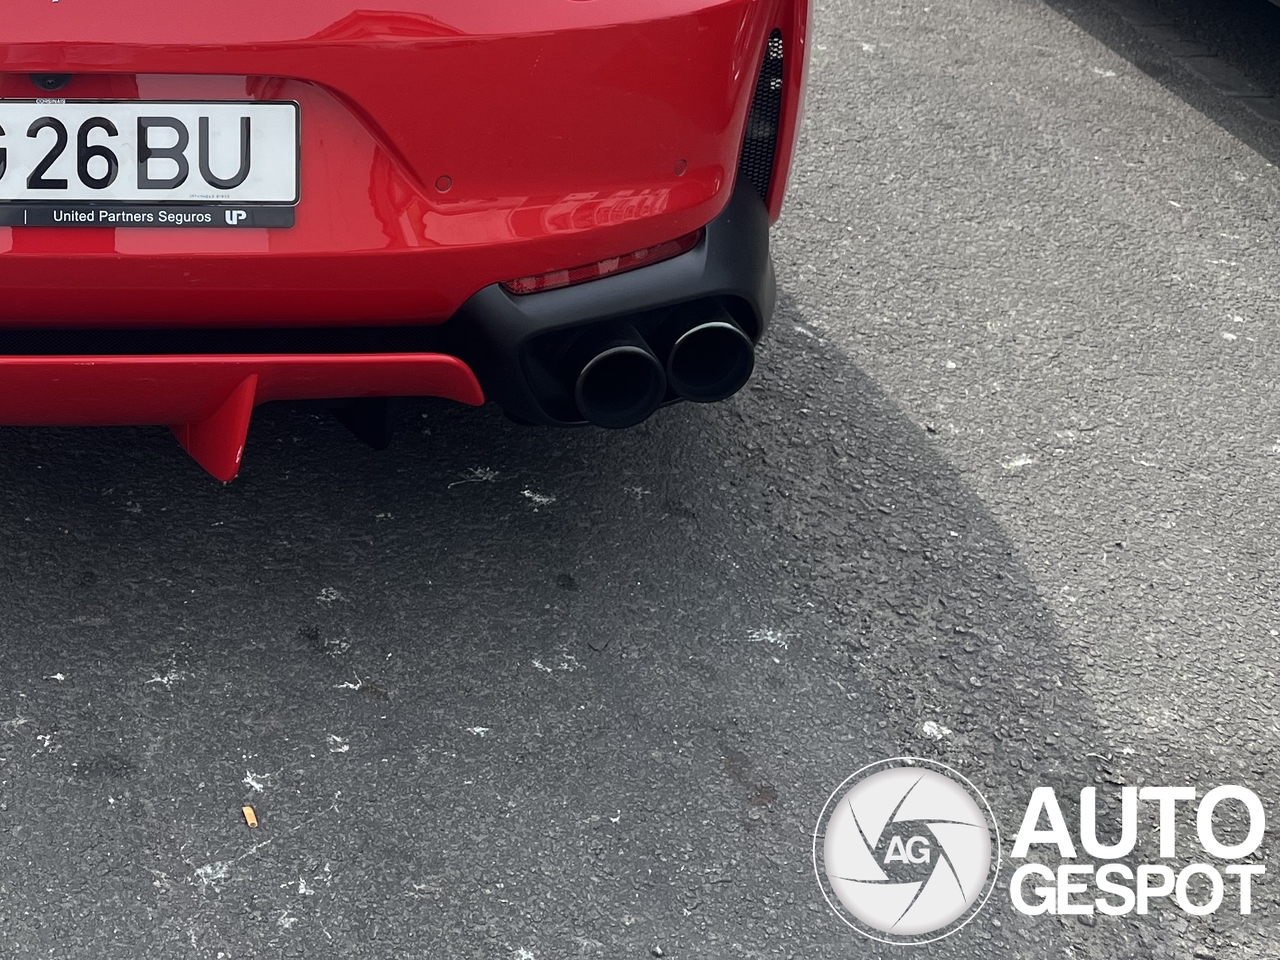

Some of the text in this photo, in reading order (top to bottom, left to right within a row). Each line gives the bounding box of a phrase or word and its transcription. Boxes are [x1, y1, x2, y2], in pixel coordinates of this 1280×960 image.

[53, 210, 212, 224] United Partners Seguros
